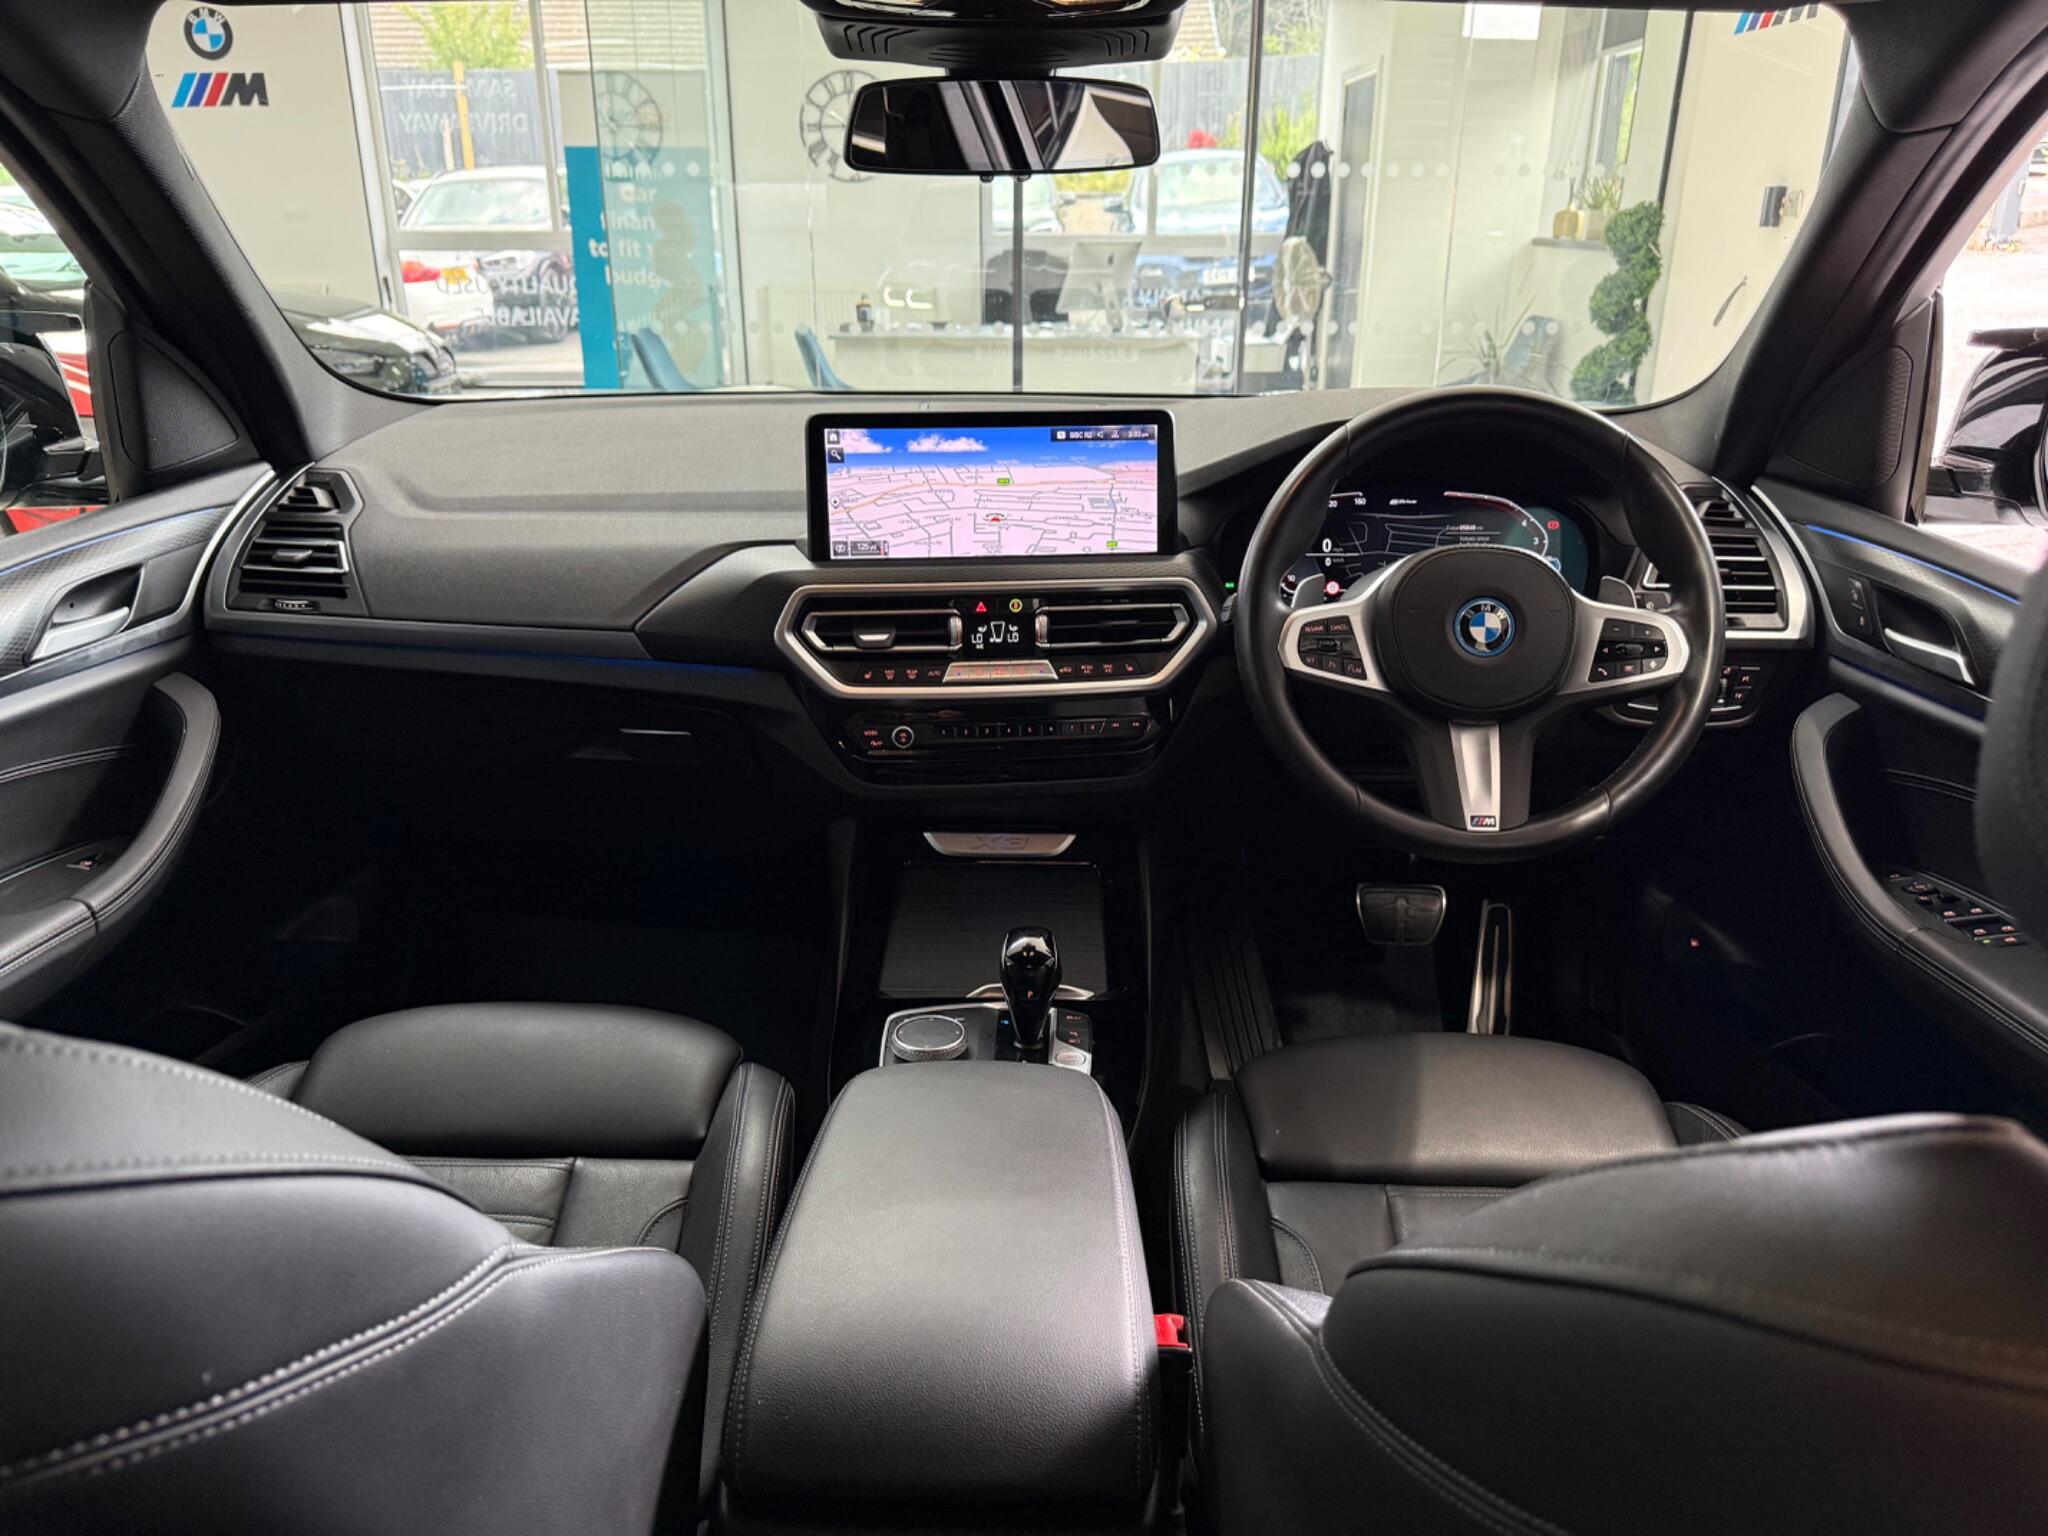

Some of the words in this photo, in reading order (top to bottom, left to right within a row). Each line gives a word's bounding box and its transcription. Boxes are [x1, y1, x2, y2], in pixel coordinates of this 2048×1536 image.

[1322, 538, 1332, 553] 0
[1325, 557, 1332, 567] 0
[1007, 632, 1019, 643] LO
